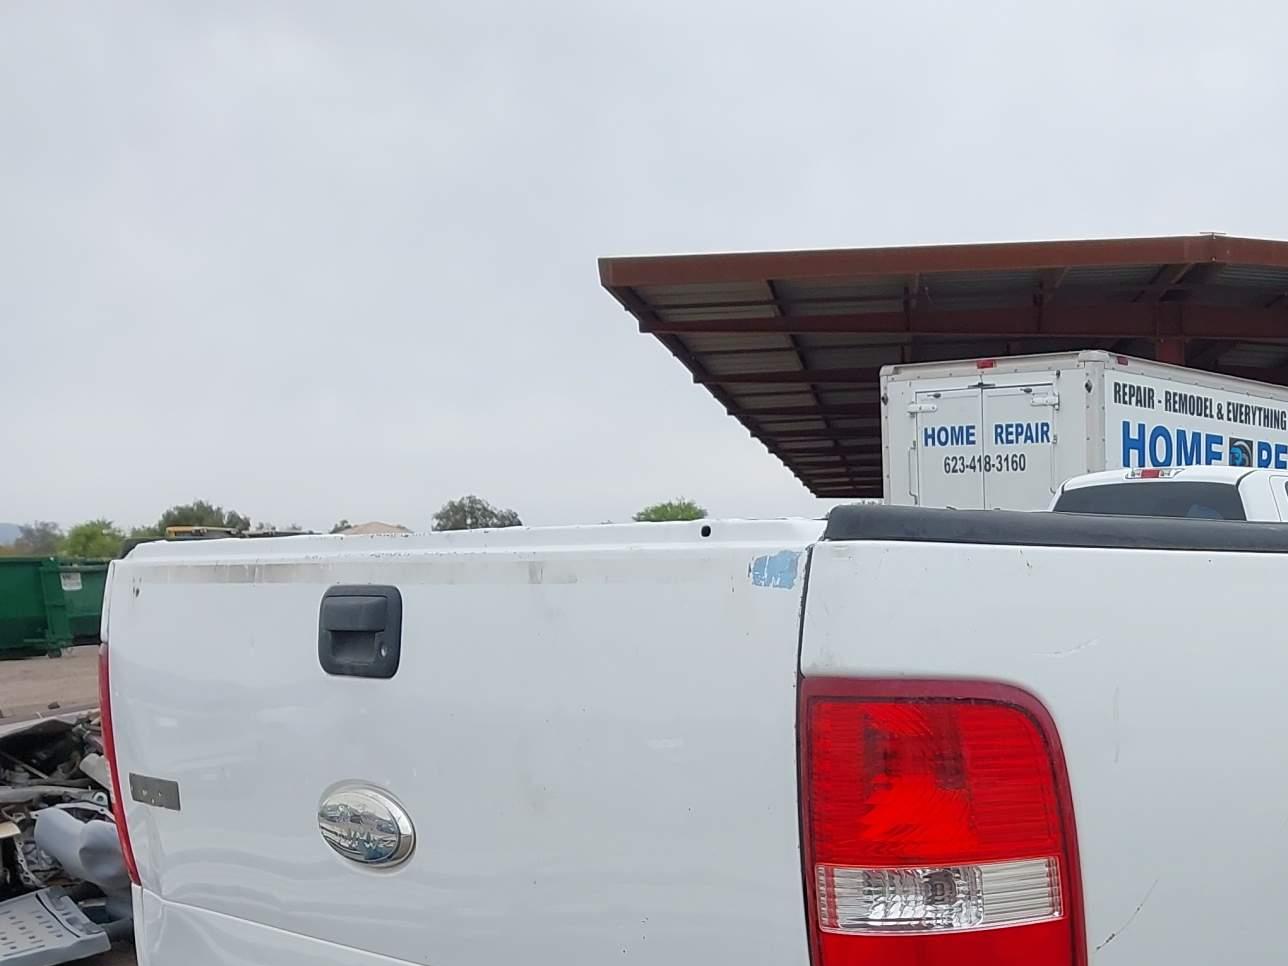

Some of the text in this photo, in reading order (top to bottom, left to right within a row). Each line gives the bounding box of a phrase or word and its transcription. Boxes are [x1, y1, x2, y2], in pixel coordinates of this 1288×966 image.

[1113, 382, 1155, 409] REPAIR
[1164, 390, 1215, 419] REMODEL
[1216, 402, 1225, 421] &
[1226, 401, 1287, 431] EVERYTHING
[924, 422, 1051, 447] HOME REPAIR
[1122, 420, 1224, 468] HOME
[944, 453, 1026, 474] 623-418-3160
